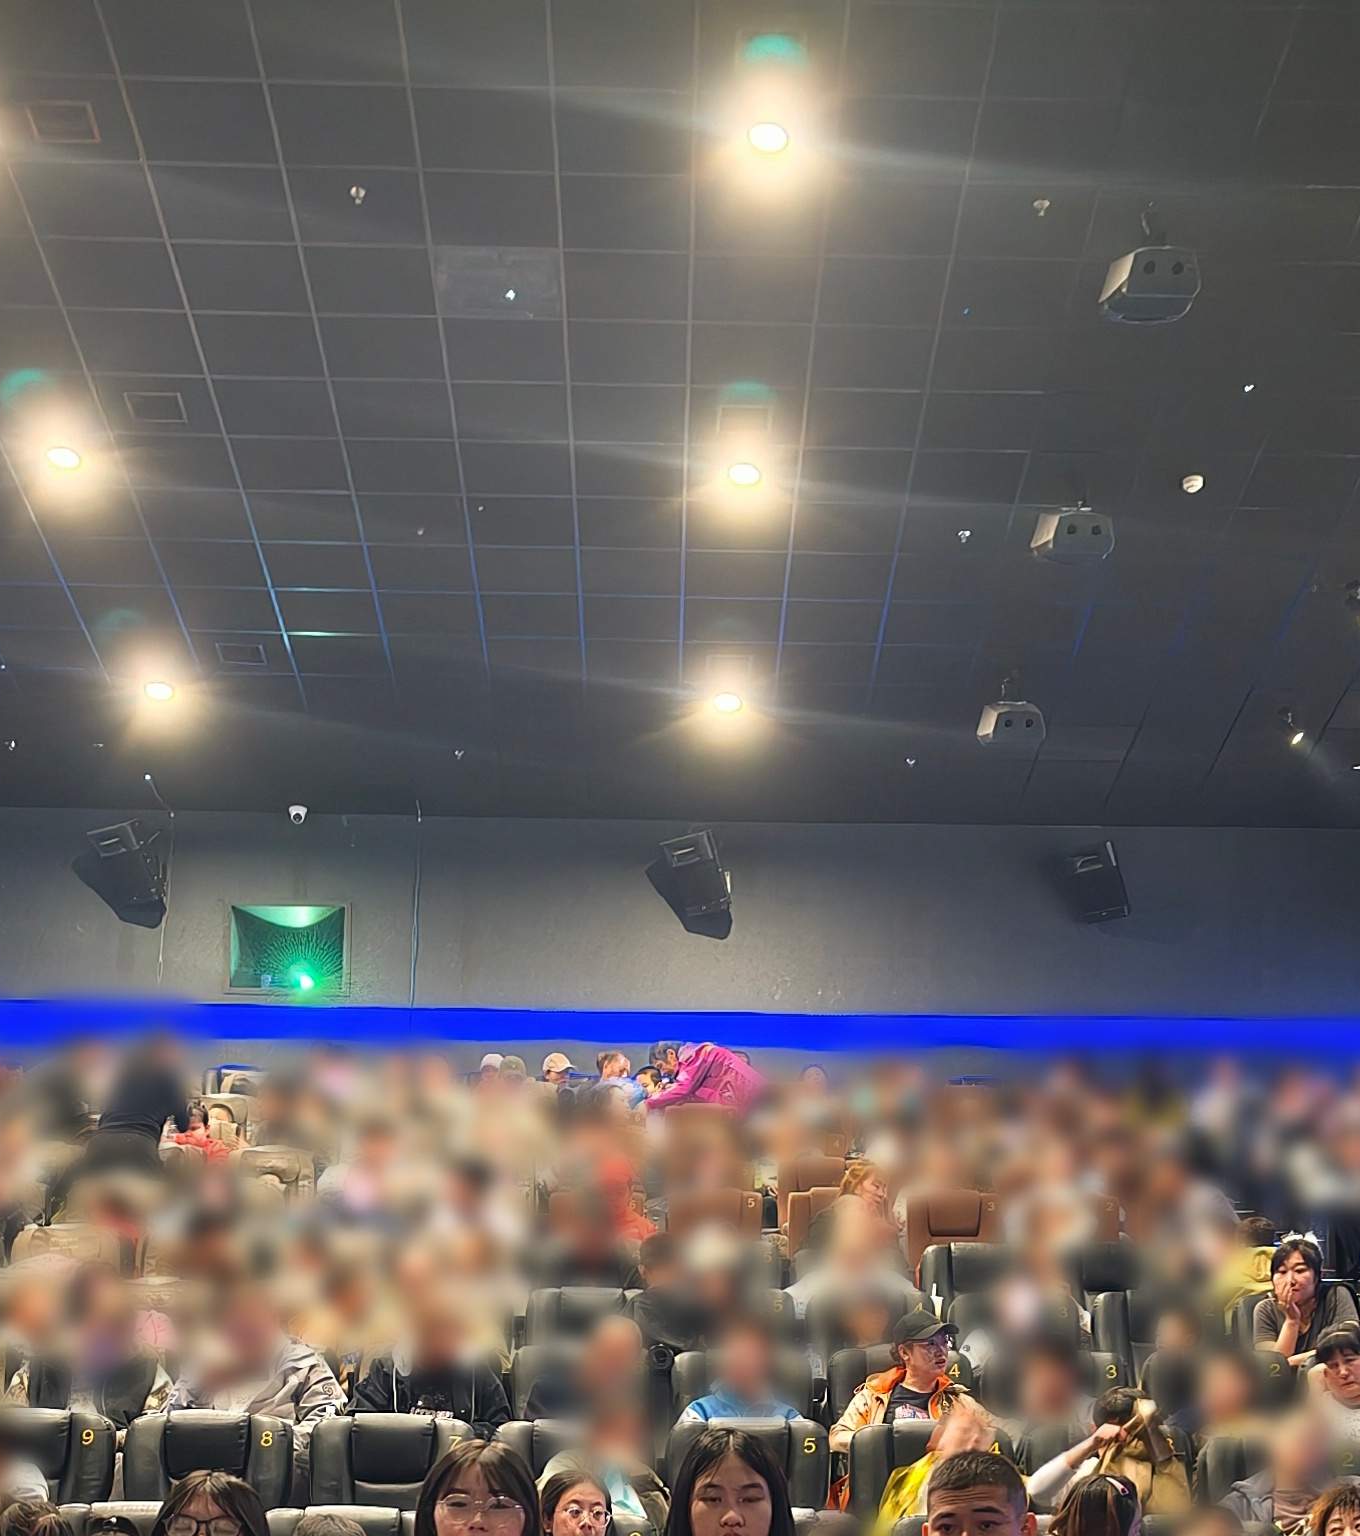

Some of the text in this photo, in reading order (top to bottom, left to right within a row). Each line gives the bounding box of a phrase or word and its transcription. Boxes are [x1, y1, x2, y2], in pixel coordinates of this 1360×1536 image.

[747, 1198, 756, 1208] 5
[949, 1363, 961, 1378] 4
[1105, 1364, 1118, 1379] 3
[1269, 1363, 1282, 1377] 2
[81, 1429, 94, 1445] 9
[261, 1431, 273, 1447] 8
[449, 1435, 462, 1448] 7
[803, 1437, 817, 1454] 5
[989, 1442, 1001, 1455] 4
[1342, 1450, 1355, 1467] 2
